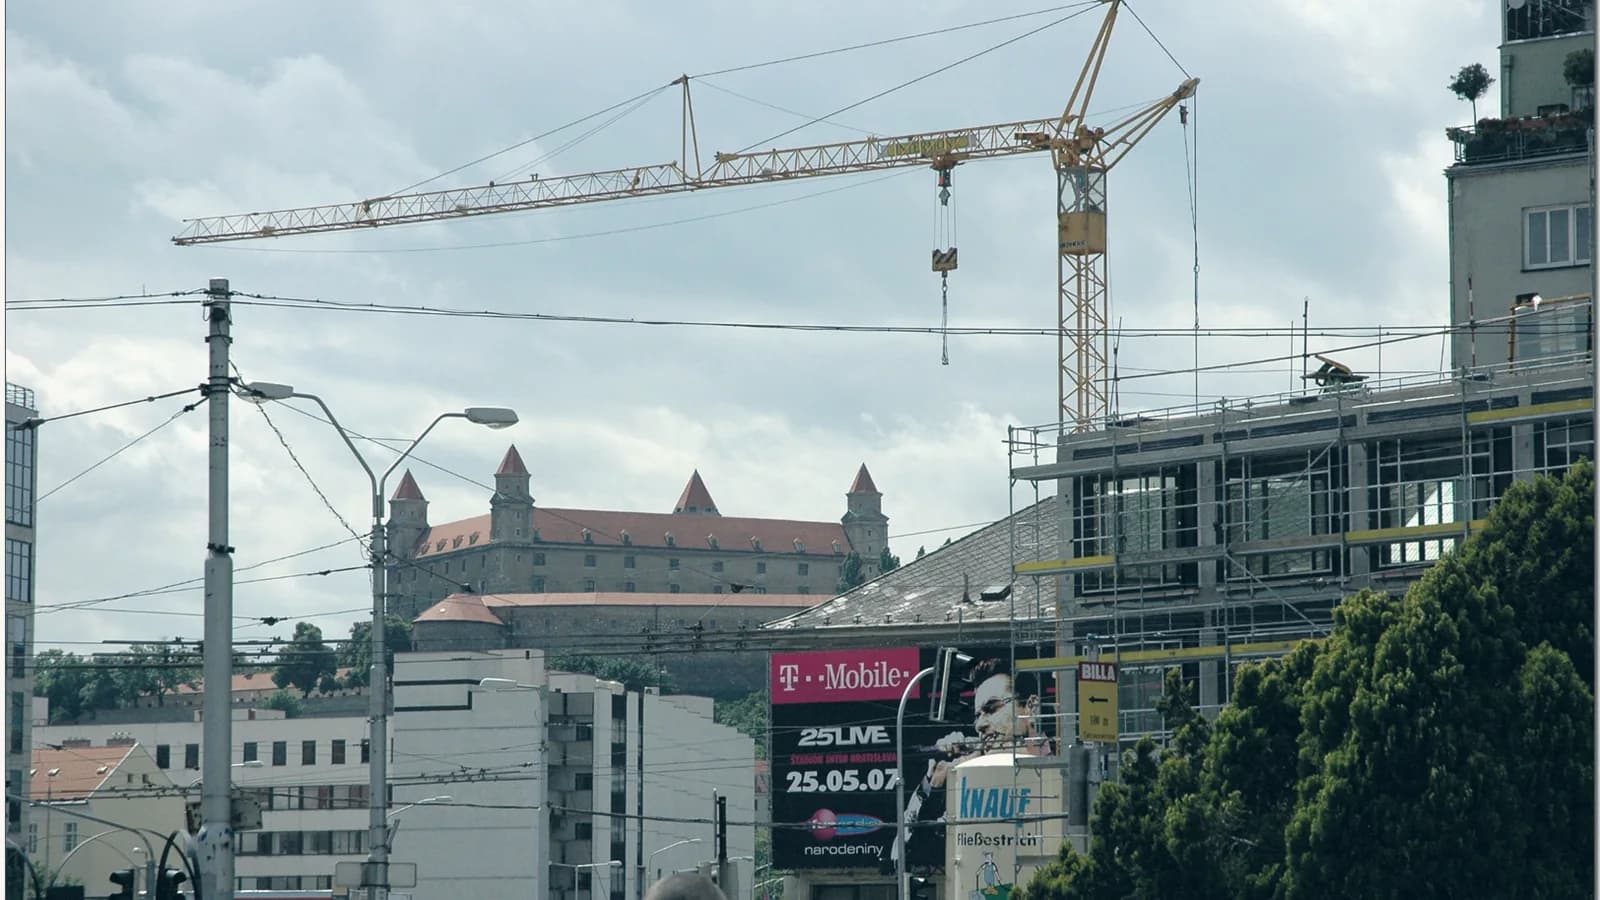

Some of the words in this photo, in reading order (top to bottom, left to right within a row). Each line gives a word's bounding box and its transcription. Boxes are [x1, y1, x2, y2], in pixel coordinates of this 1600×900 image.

[1081, 663, 1115, 681] BILLA
[786, 768, 899, 793] 25.05.07
[804, 843, 884, 857] narodeniny
